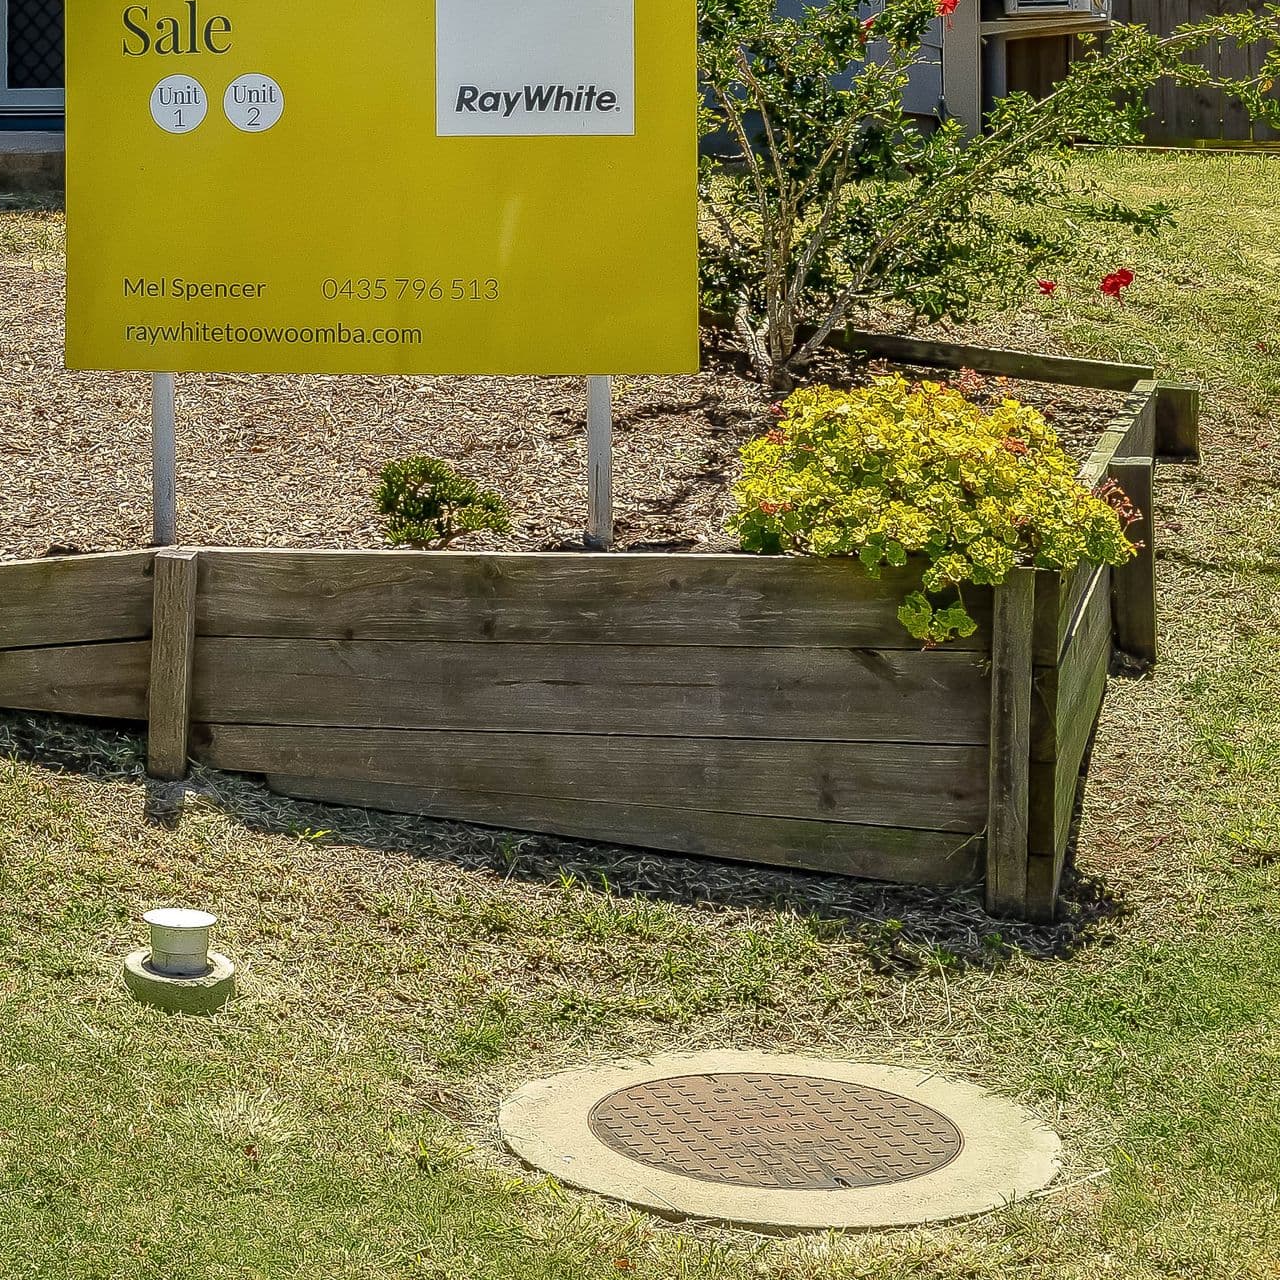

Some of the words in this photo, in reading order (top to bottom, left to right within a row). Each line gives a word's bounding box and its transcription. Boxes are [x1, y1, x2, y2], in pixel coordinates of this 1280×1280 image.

[122, 0, 232, 57] Sale
[158, 85, 201, 106] Unit
[233, 84, 277, 104] Unit
[173, 109, 186, 127] 1
[247, 107, 261, 126] 2
[124, 277, 165, 297] Mel
[171, 278, 266, 301] Spencer
[322, 279, 388, 300] 0435
[395, 278, 443, 300] 796
[451, 279, 500, 300] 513
[126, 321, 422, 345] raywhitetoowoomba.com
[725, 1121, 825, 1136] SEWER
